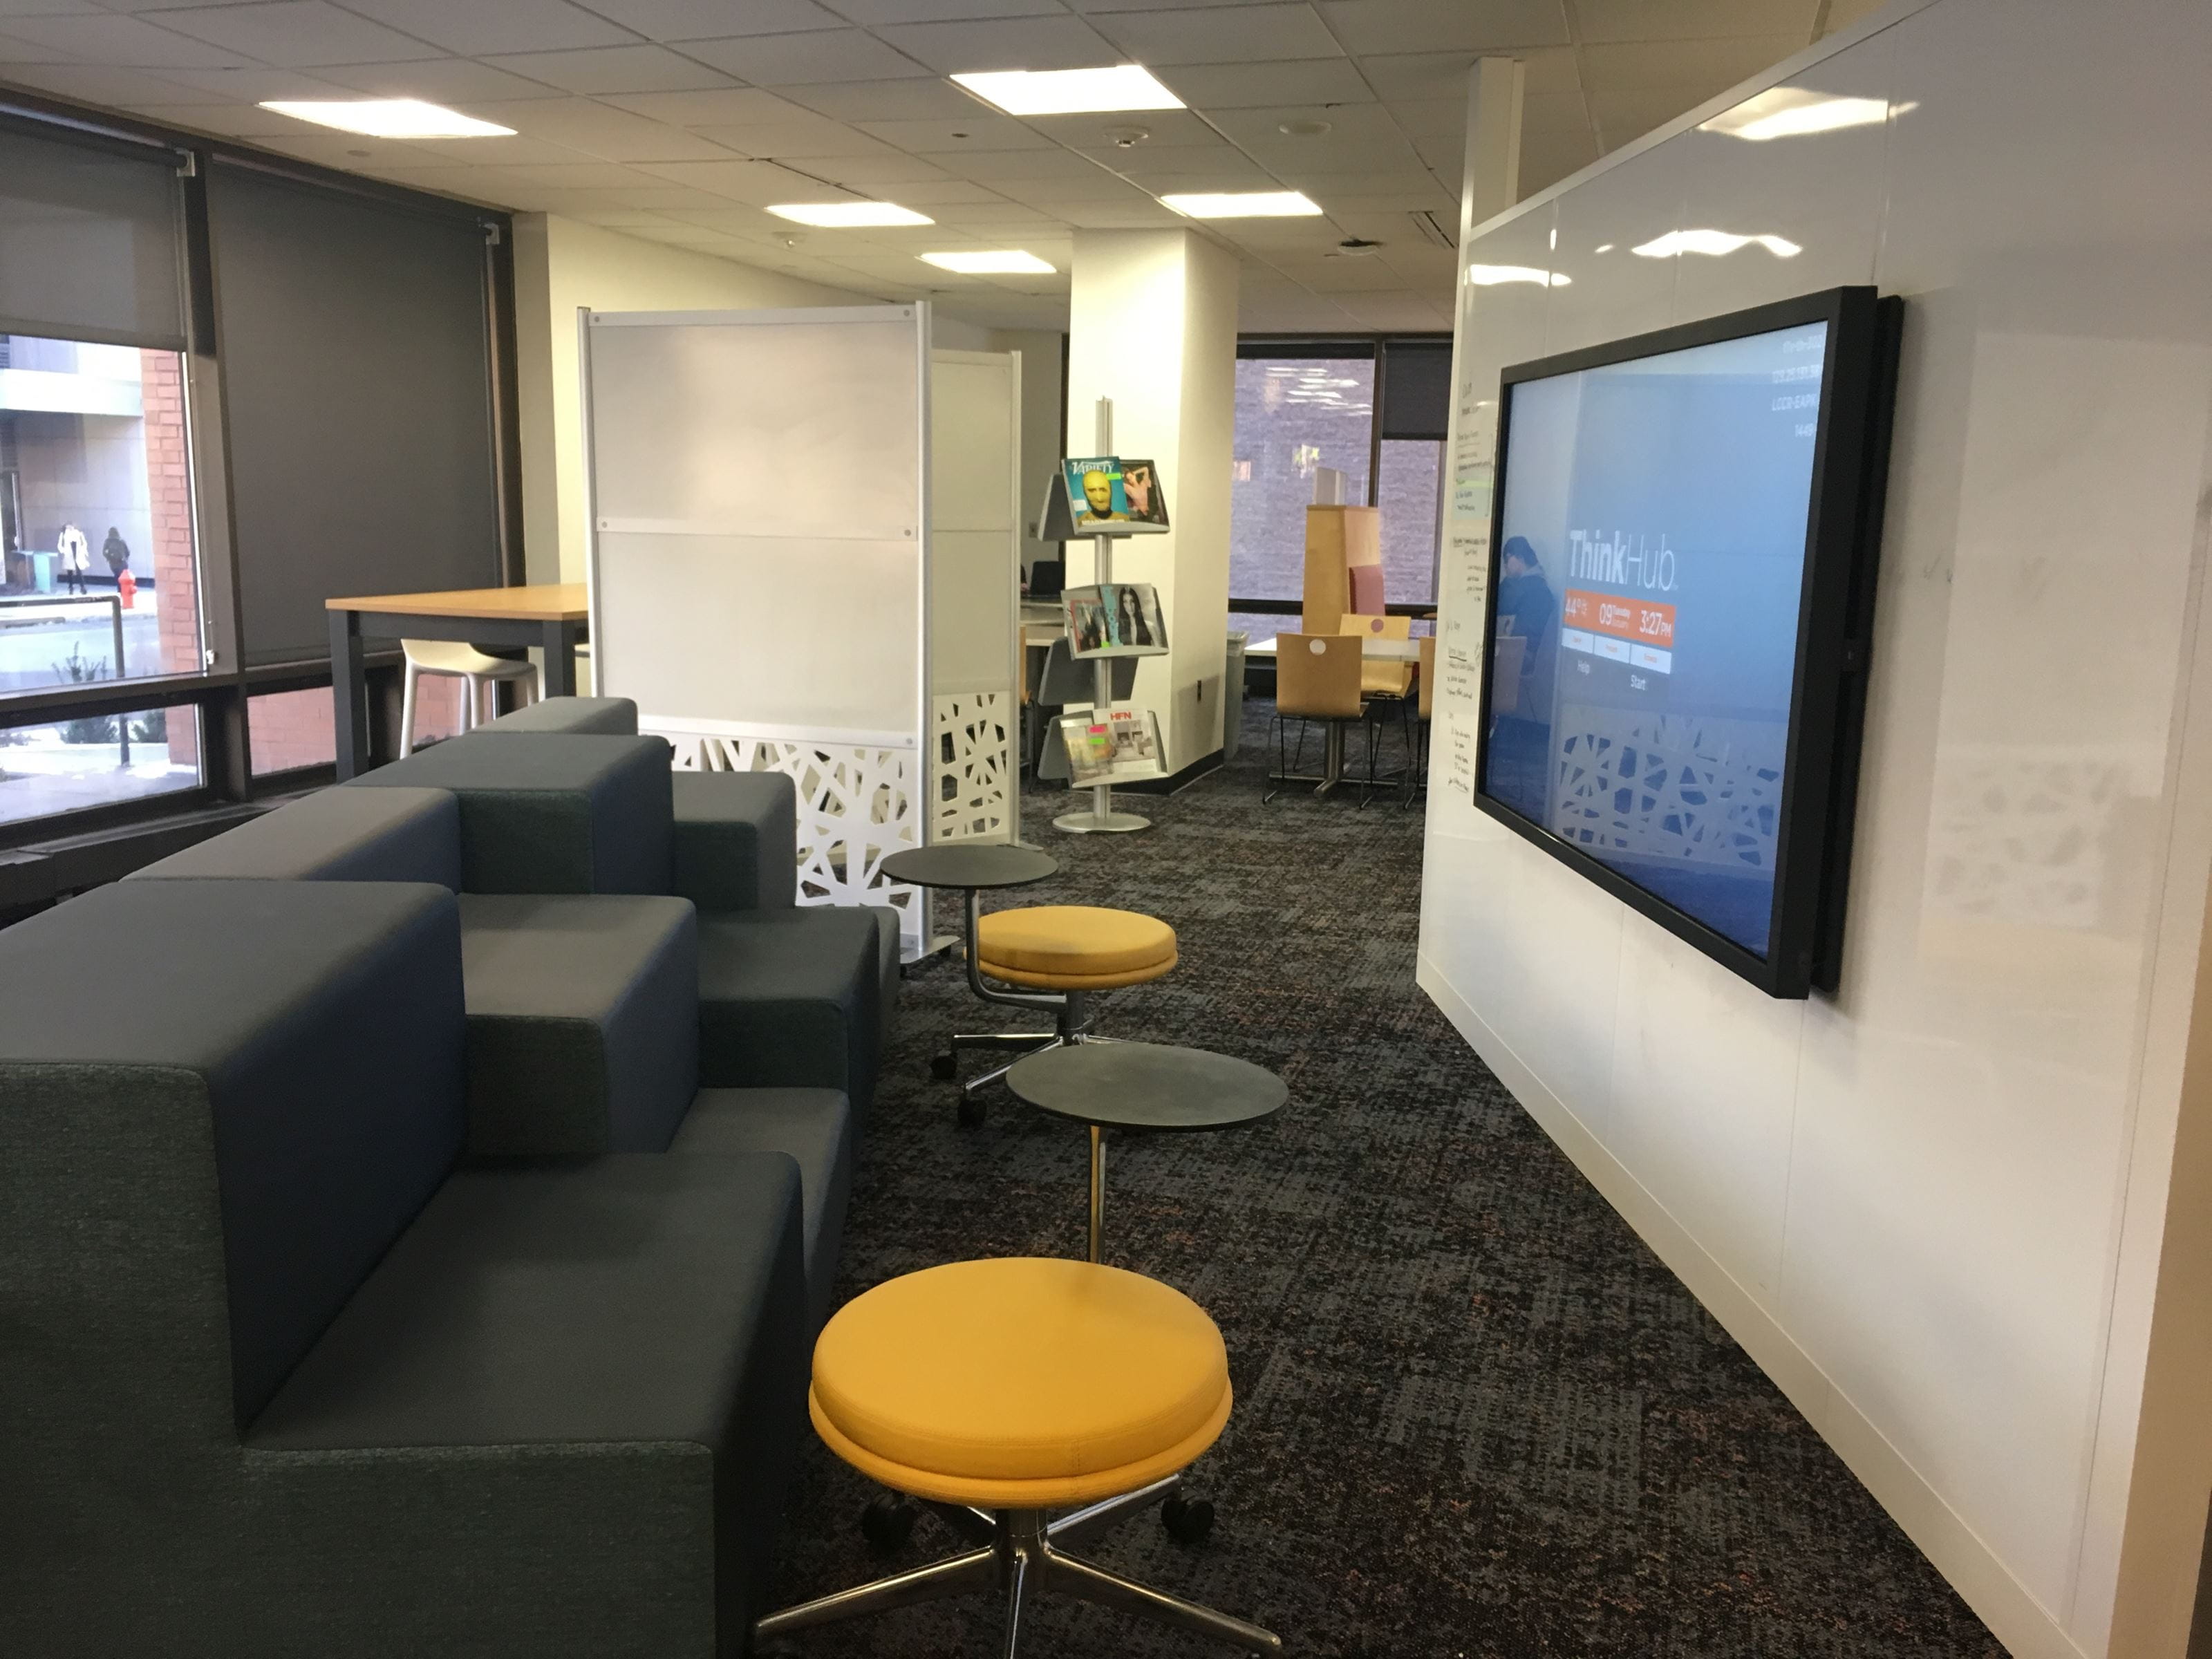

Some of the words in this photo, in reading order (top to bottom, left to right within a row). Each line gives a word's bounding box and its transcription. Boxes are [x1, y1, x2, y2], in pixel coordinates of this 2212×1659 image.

[1569, 529, 1675, 591] ThinkHub
[1599, 603, 1613, 626] 09
[1631, 675, 1647, 691] Start
